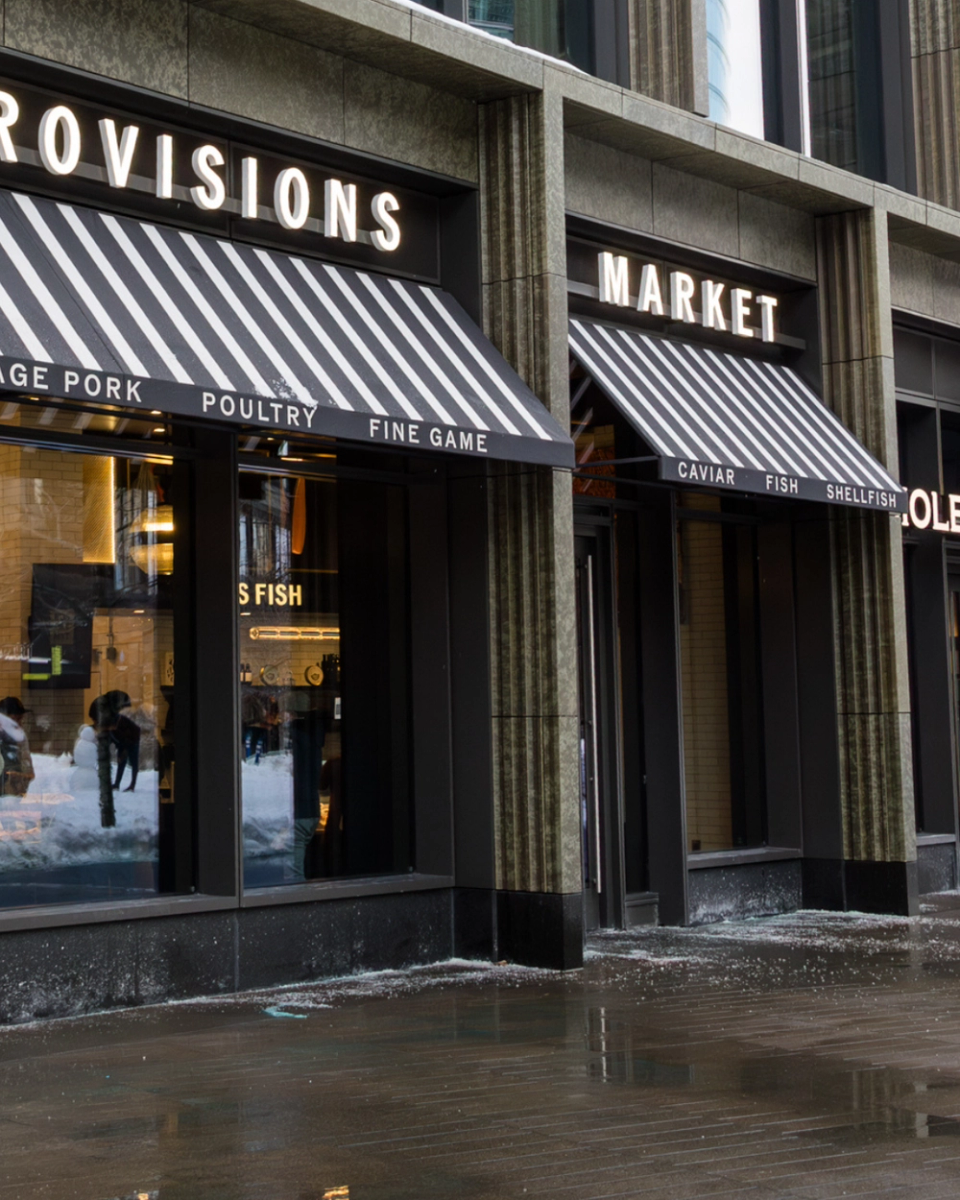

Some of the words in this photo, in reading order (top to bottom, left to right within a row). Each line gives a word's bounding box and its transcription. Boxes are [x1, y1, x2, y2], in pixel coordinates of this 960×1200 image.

[597, 251, 778, 343] MARKET
[64, 370, 142, 403] PORK
[202, 391, 316, 429] POULTRY
[369, 418, 420, 444] FINE
[429, 427, 488, 453] GAME
[677, 461, 735, 486] CAVIAR
[765, 474, 799, 494] FISH
[826, 483, 897, 508] SHELLFISH
[255, 583, 302, 606] FISH
